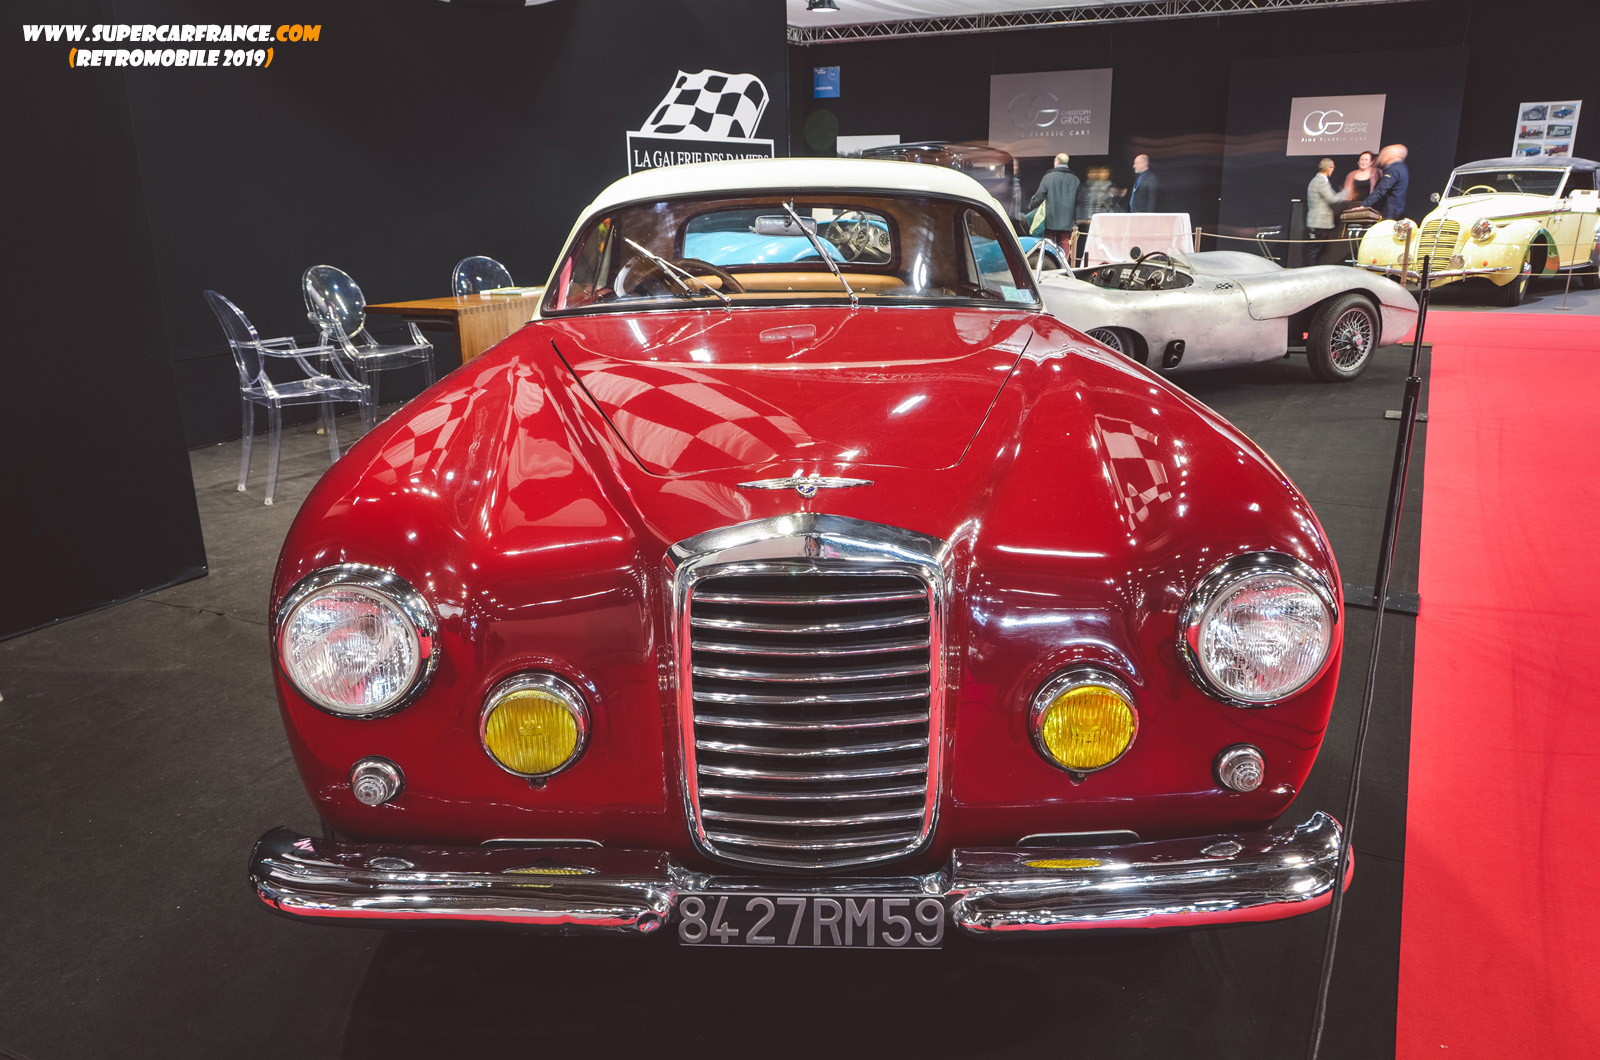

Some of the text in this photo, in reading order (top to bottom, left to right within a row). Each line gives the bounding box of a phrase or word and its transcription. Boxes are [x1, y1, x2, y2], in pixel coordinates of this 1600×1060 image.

[1061, 116, 1091, 124] GROHE
[1029, 130, 1065, 138] CLASSIC
[634, 150, 652, 168] LA
[653, 150, 702, 168] GALERIE
[678, 896, 945, 946] 8427RM59
